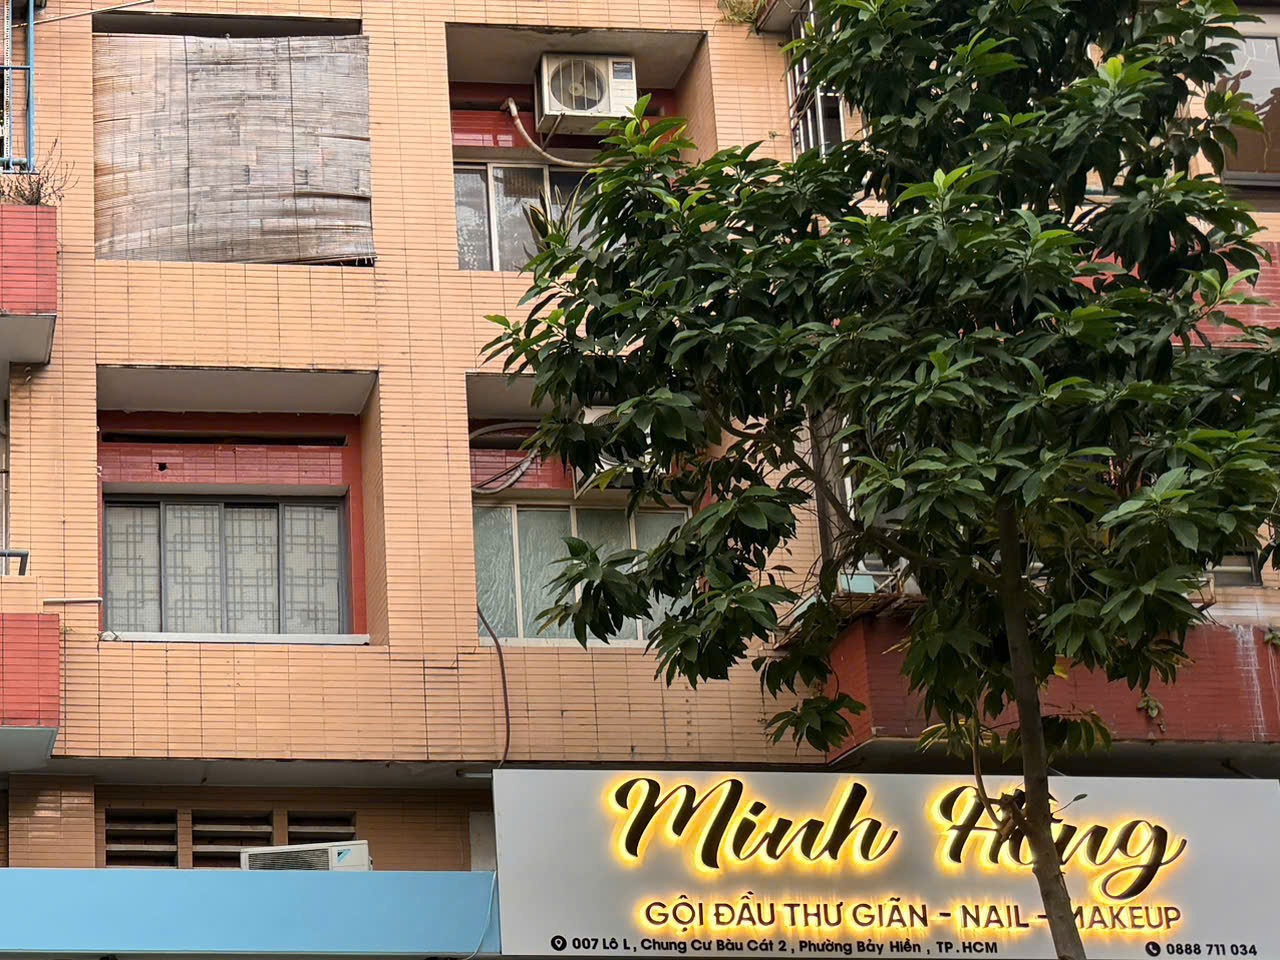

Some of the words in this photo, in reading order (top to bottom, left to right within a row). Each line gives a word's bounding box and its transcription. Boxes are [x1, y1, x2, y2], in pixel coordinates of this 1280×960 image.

[614, 777, 899, 869] Minh
[939, 785, 1188, 900] Hng
[644, 894, 704, 933] GỘI
[713, 890, 775, 927] ĐẦU
[784, 901, 843, 928] THƯ
[852, 896, 929, 928] GIÃN
[961, 904, 1029, 928] NAIL
[572, 938, 599, 950] 007
[602, 937, 618, 950] Lô
[640, 938, 687, 954] Chung
[690, 938, 712, 951] Cư
[716, 939, 743, 951] Bàu
[746, 939, 774, 951] Cát
[799, 940, 853, 955] Phường
[856, 939, 884, 955] Bảy
[1166, 943, 1201, 955] 0888
[1205, 944, 1225, 955] 711
[1230, 944, 1258, 956] 034
